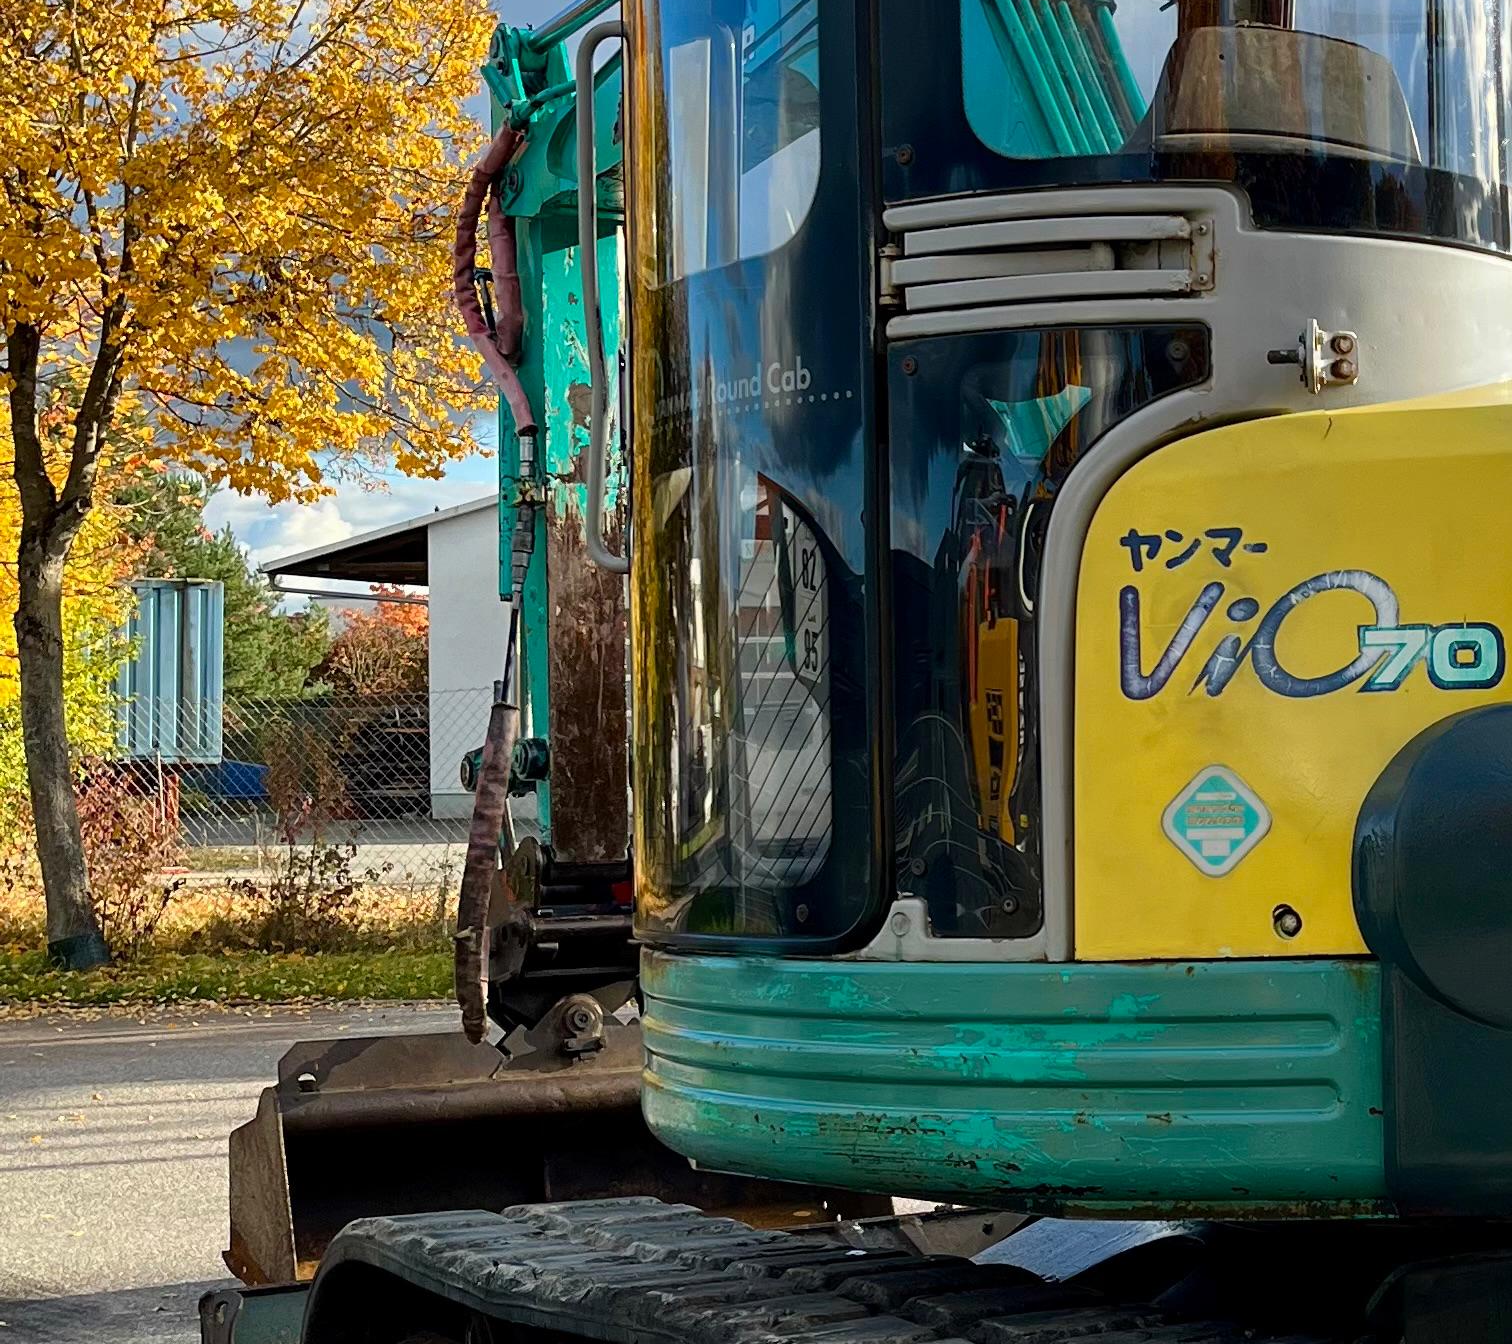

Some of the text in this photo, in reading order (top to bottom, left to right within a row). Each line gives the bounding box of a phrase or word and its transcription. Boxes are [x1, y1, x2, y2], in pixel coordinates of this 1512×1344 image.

[766, 356, 812, 394] Cab
[1120, 527, 1268, 571] ヤンマー
